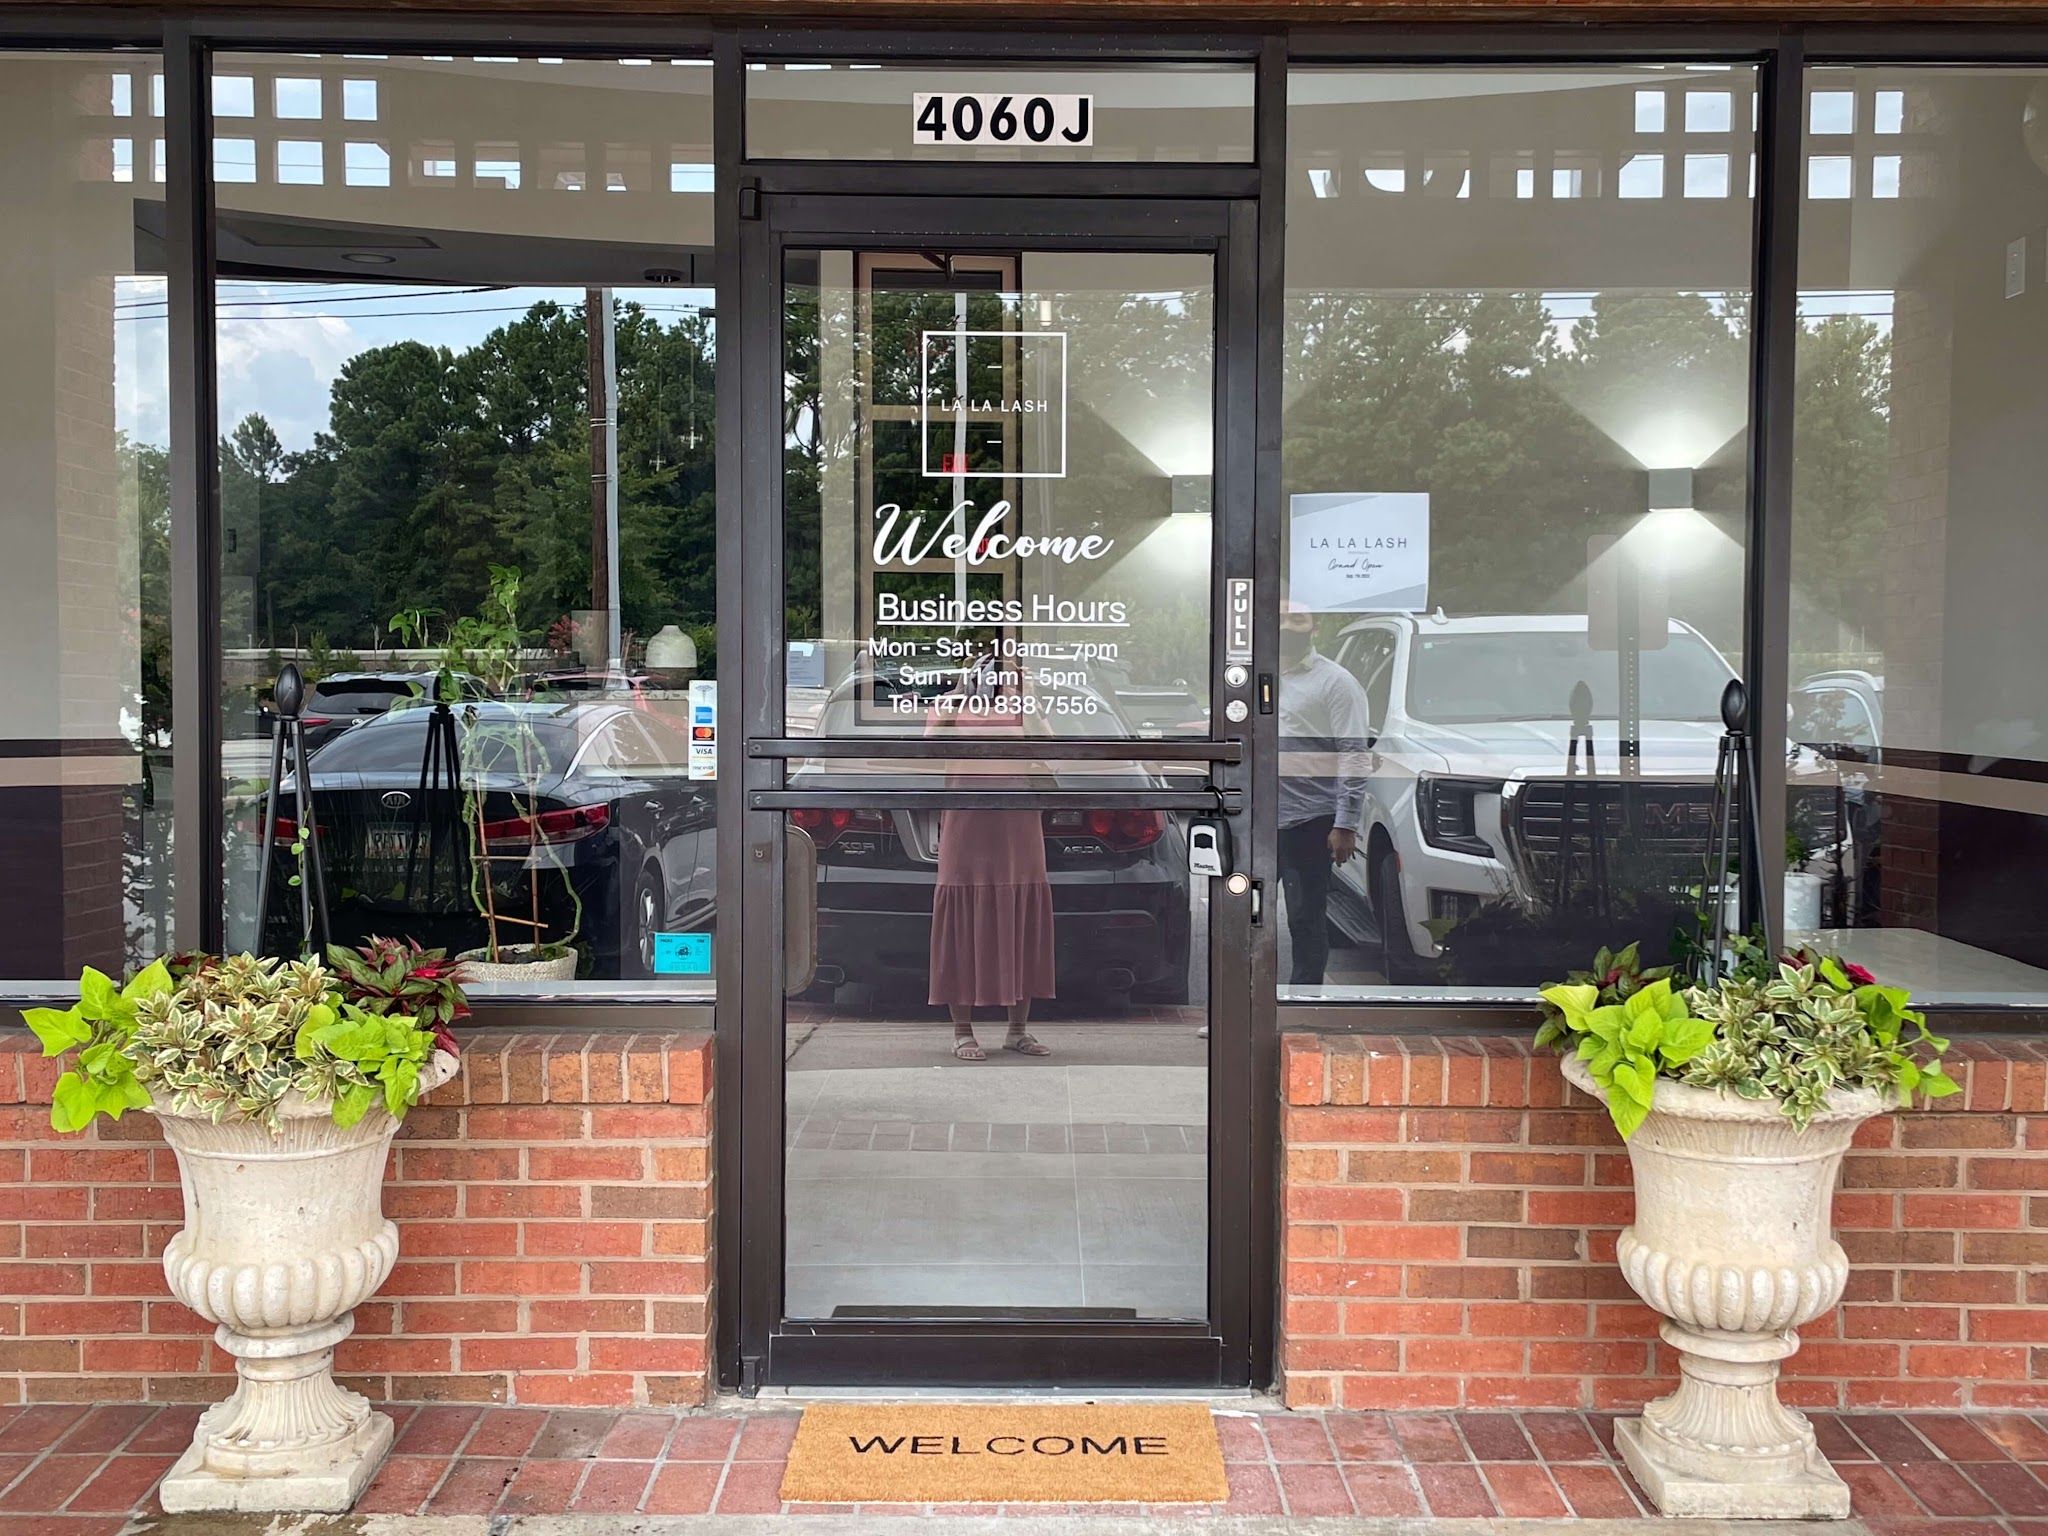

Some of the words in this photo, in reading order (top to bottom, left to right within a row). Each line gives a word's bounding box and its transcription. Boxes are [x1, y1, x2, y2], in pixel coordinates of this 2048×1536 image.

[917, 96, 1089, 142] 4060J
[941, 399, 963, 412] LA
[971, 400, 992, 412] LA
[1001, 400, 1048, 412] LASH
[873, 500, 1114, 566] Welcome
[1310, 537, 1329, 549] LA
[1338, 537, 1356, 549] LA
[1365, 537, 1407, 549] LASH
[878, 593, 1022, 622] Business
[1032, 594, 1126, 622] Hours
[1234, 582, 1248, 646] PULL
[869, 638, 916, 657] Mon
[936, 638, 973, 658] Sat
[991, 639, 1049, 658] 10am
[1070, 643, 1118, 662] 7pm
[899, 666, 941, 686] Sun
[961, 667, 1019, 686] 11am
[1039, 668, 1087, 690] 5pm
[888, 695, 919, 714] Tel
[934, 695, 990, 716] (470)
[994, 696, 1036, 715] 838
[1043, 697, 1097, 715] 7556
[849, 1436, 1169, 1456] WELCOME
